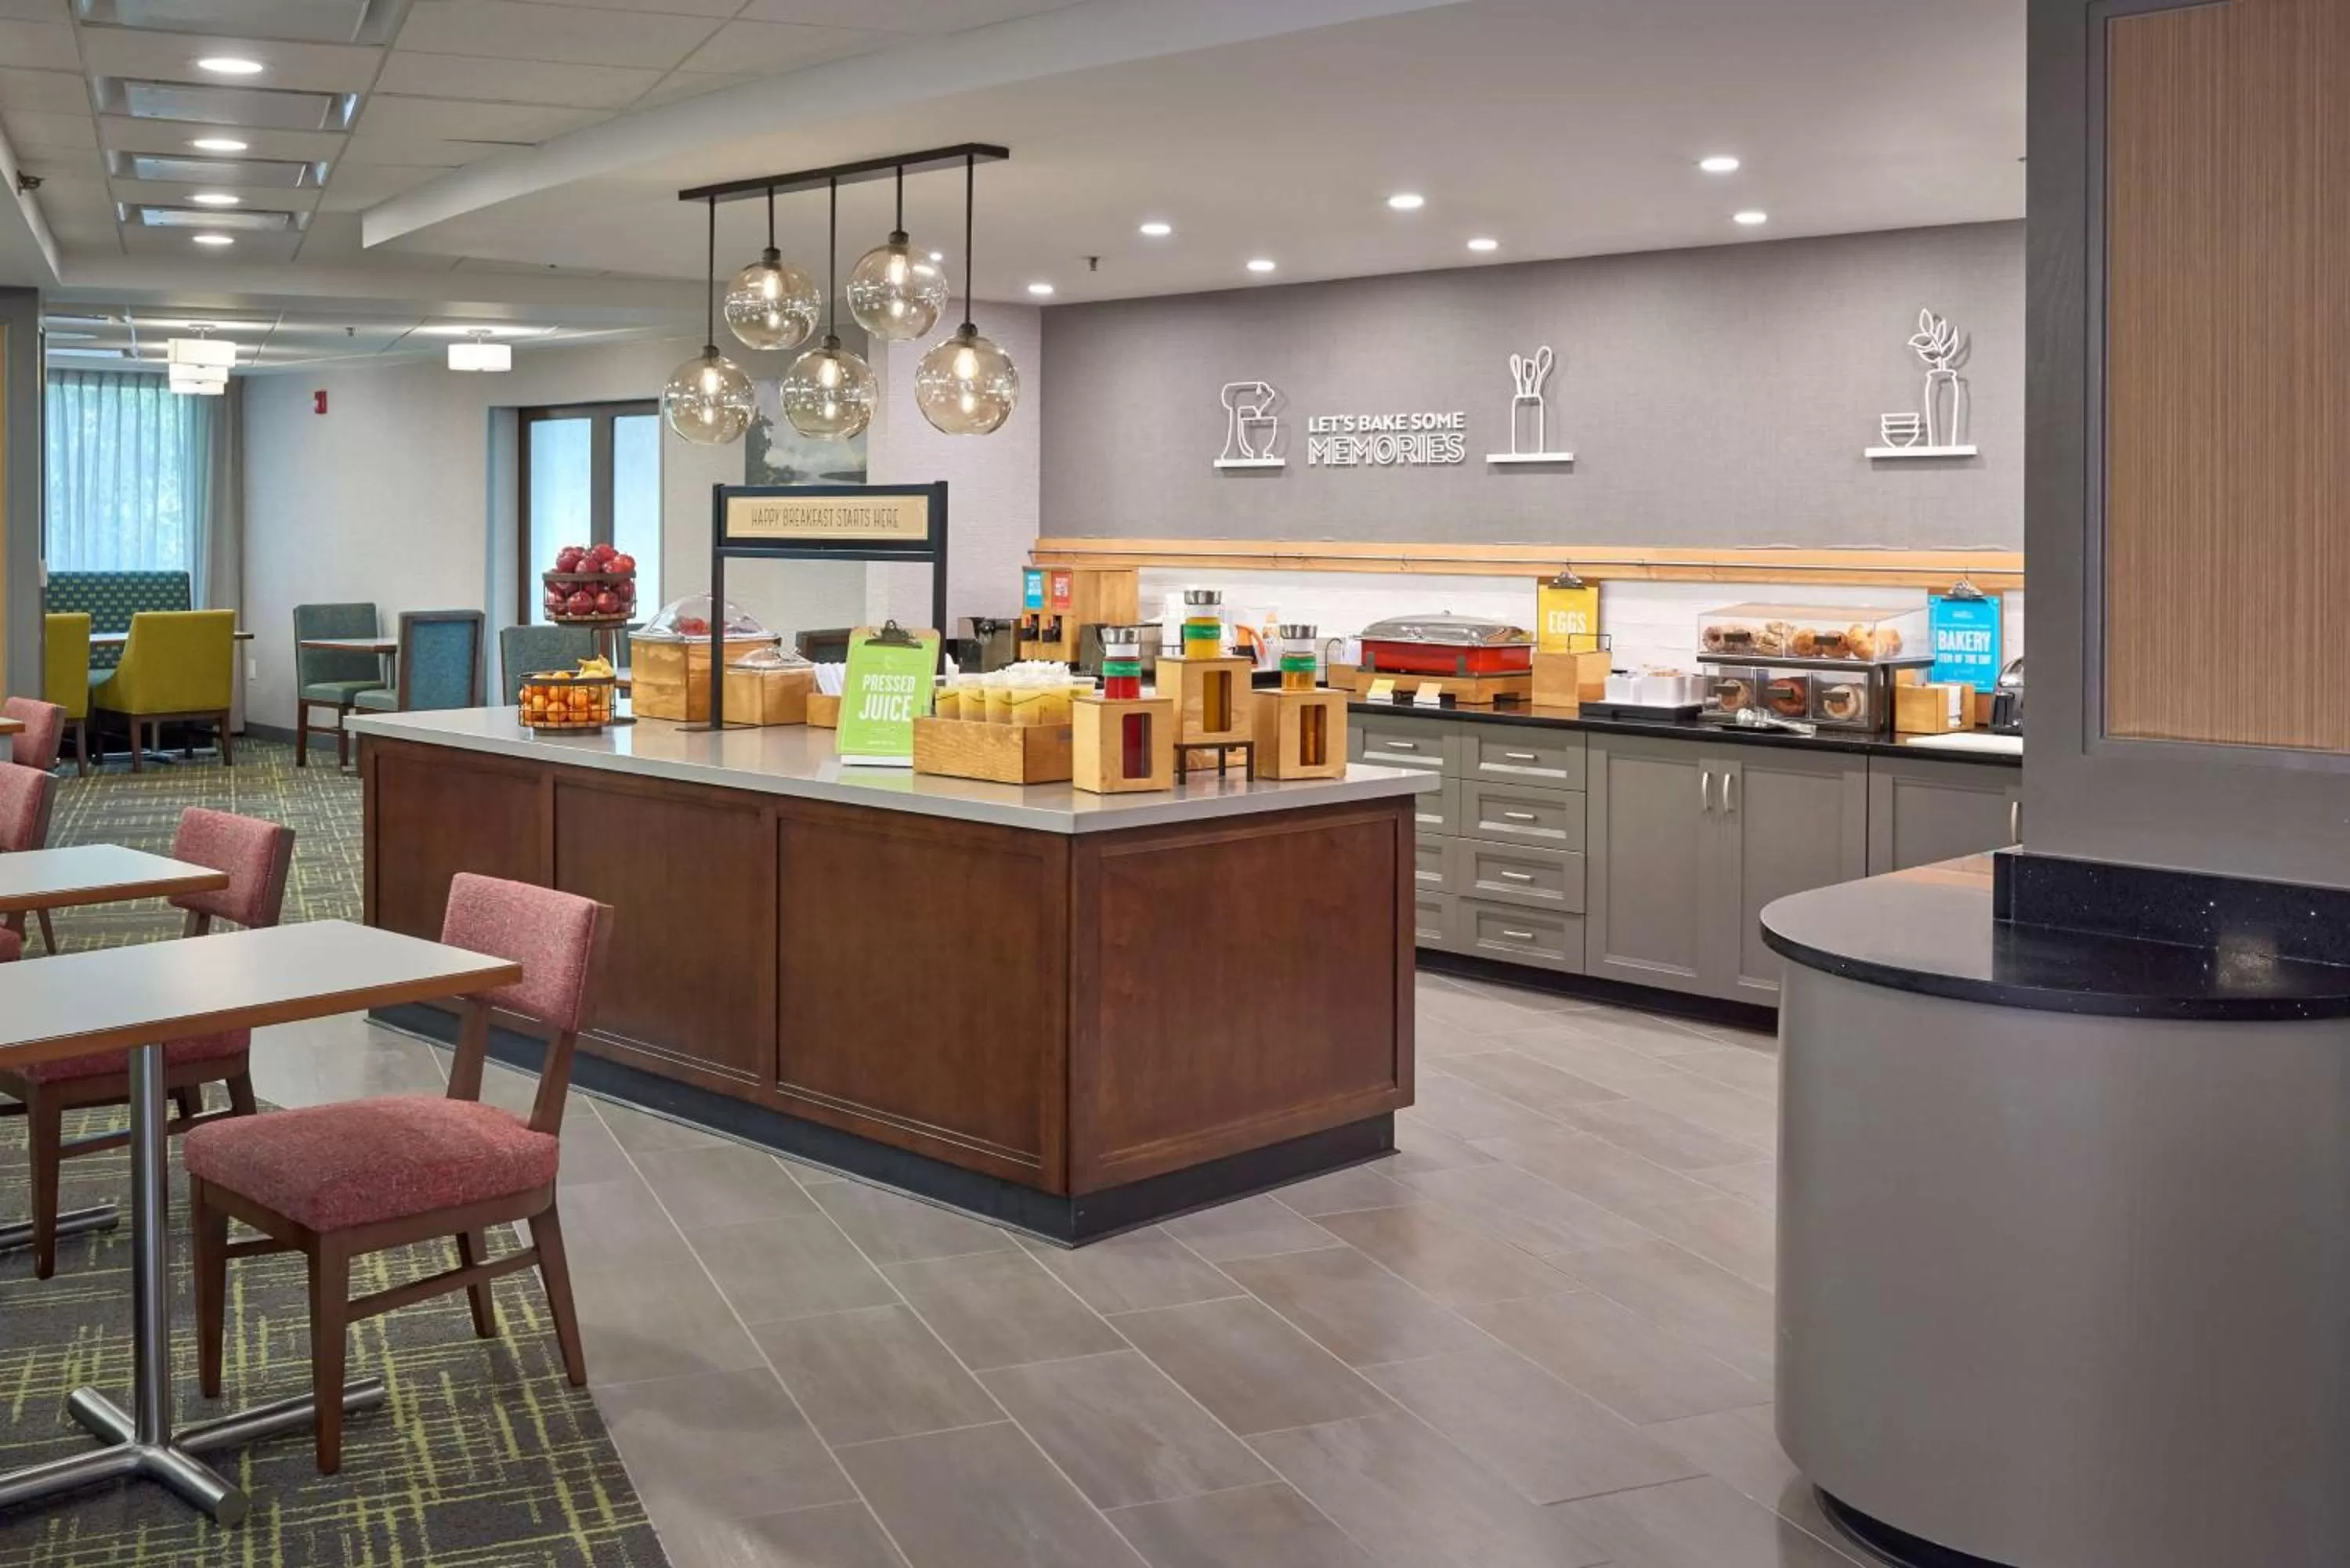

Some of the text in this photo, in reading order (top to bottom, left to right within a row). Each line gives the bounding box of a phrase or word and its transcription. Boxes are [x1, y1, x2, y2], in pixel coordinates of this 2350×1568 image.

[1308, 411, 1466, 432] LET'S BAKE SOME
[1307, 433, 1466, 465] MEMORIES
[751, 508, 900, 528] HAPPY BREAKFAST STARTS HERE
[1548, 610, 1587, 634] EGGS
[1937, 630, 1992, 652] BAKERY
[862, 674, 916, 692] PRESSED
[859, 693, 915, 722] JUICE
